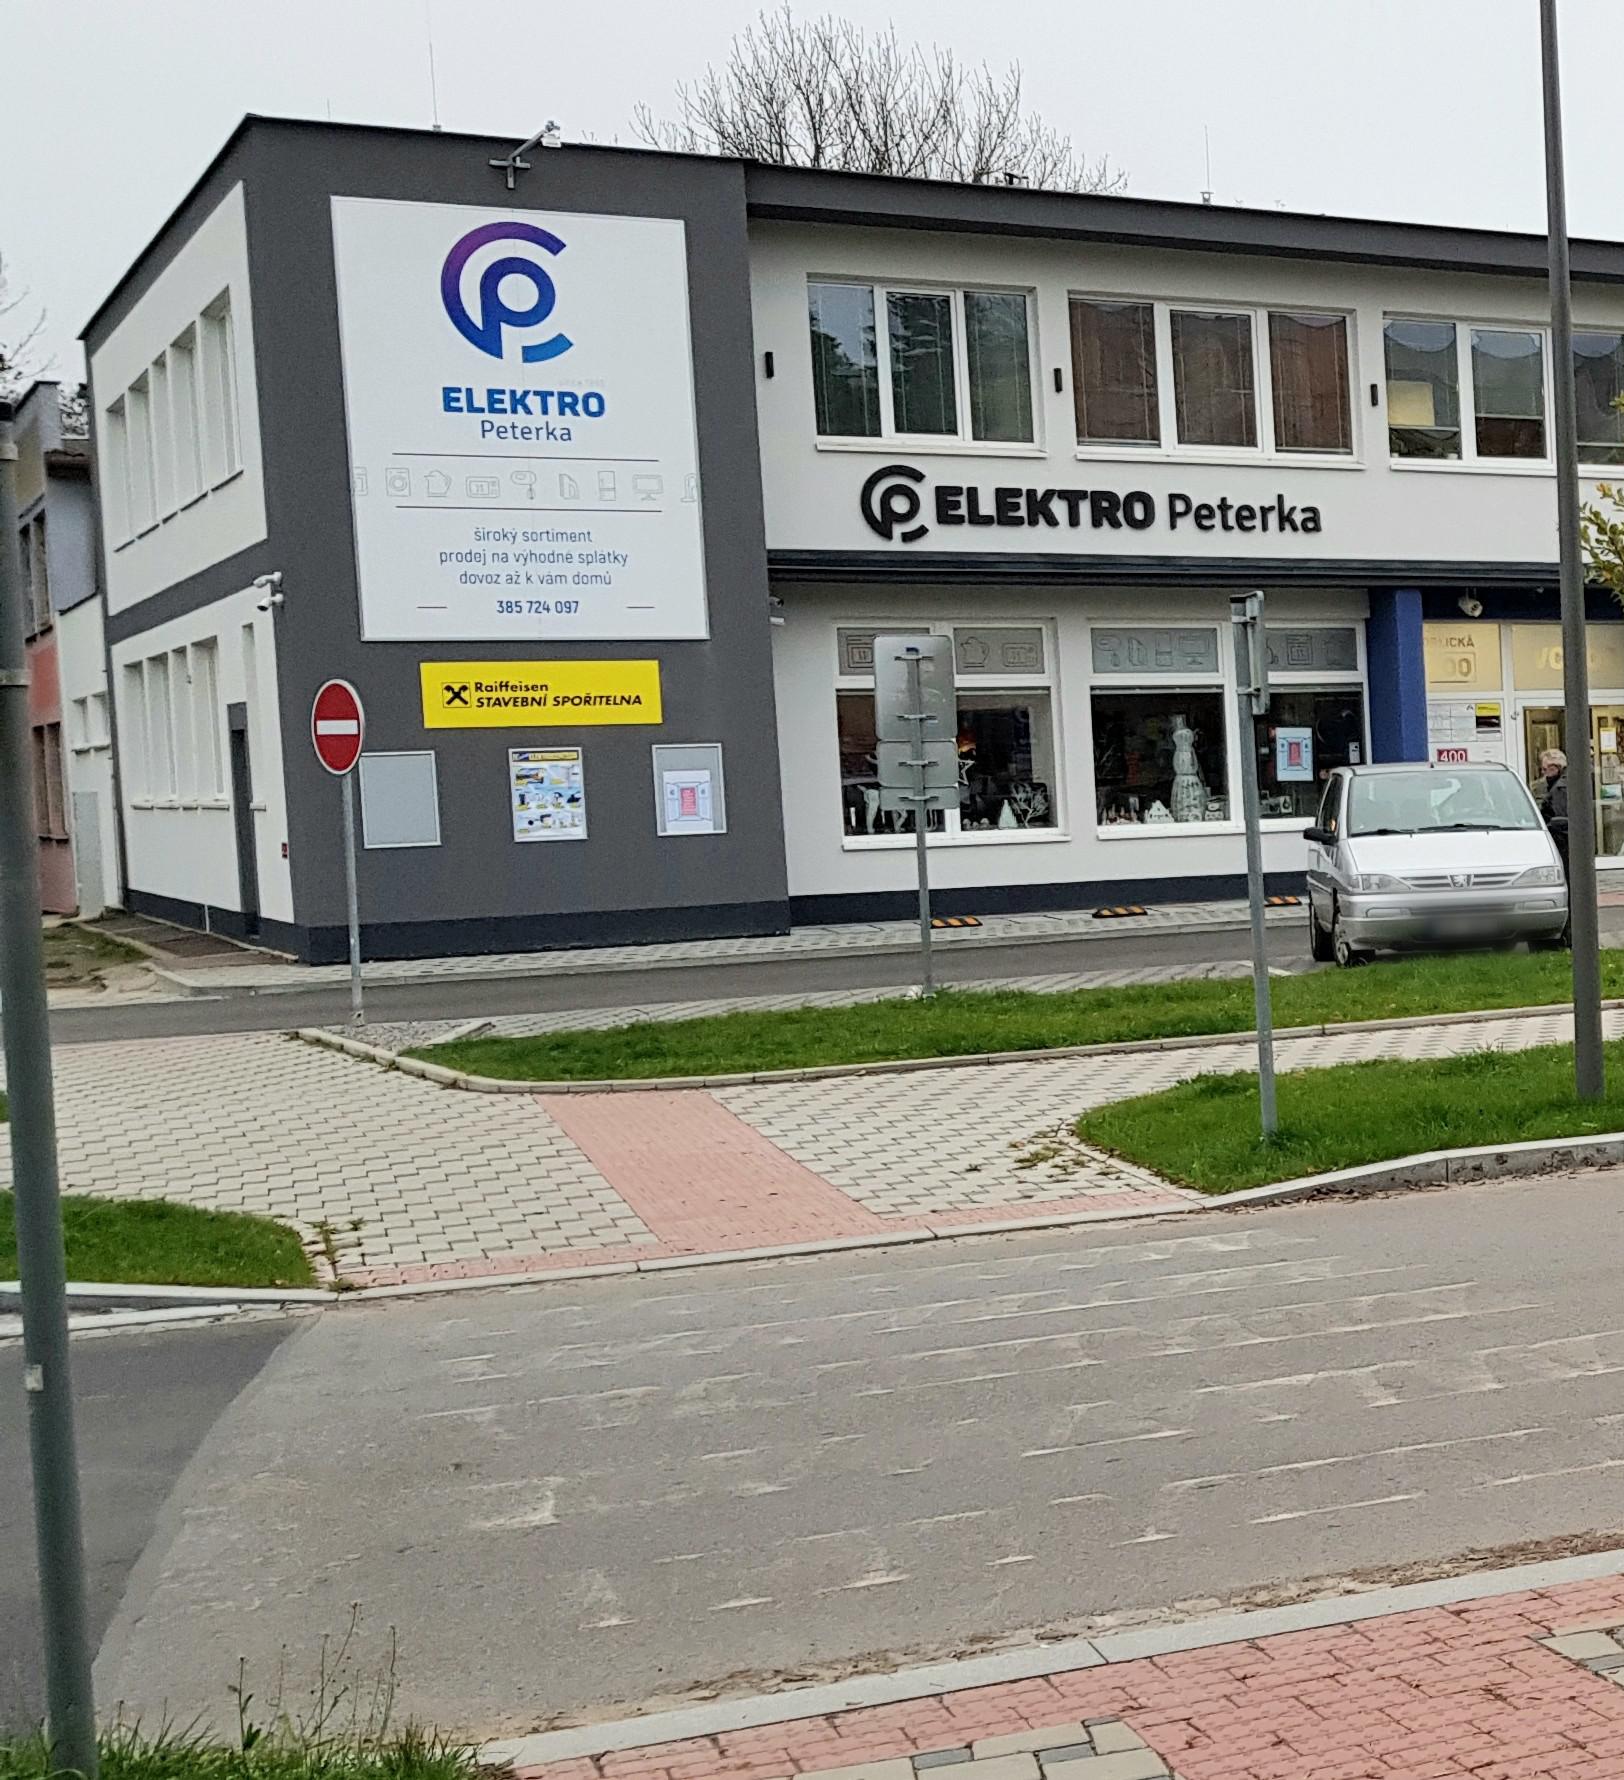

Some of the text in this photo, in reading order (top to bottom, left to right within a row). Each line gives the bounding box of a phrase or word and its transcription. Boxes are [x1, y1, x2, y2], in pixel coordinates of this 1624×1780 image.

[442, 386, 606, 418] ELEKTRO
[480, 419, 572, 442] Peterka
[934, 485, 1156, 531] ELEKTRO
[1167, 493, 1322, 534] Peterka
[474, 527, 593, 544] široký sortiment
[439, 549, 629, 567] prodej na výhodné splátky
[459, 570, 612, 586] dovoz až k vám domů
[496, 600, 580, 615] 385 724 097
[474, 681, 549, 693] Raiffeisen
[475, 692, 643, 708] STAVEBNÍ SPOŘITELNA
